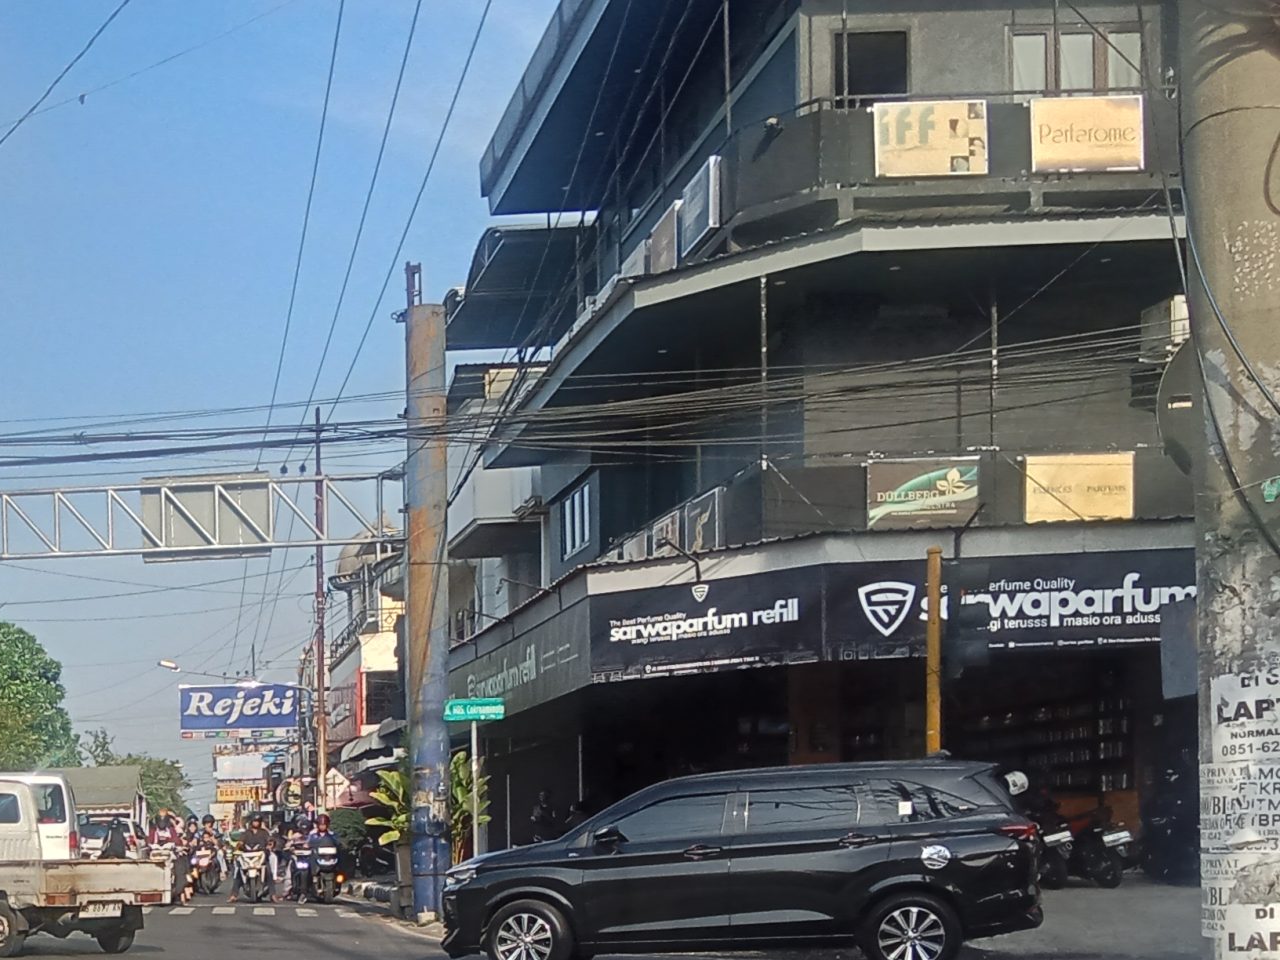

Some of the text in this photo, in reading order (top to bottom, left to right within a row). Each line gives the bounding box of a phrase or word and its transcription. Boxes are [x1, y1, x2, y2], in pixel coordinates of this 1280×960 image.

[988, 576, 1076, 593] erfume Quality
[609, 598, 799, 642] sarwaparfum refill
[1063, 614, 1101, 628] masio
[1102, 613, 1123, 626] ora
[183, 689, 295, 725] Rejeki
